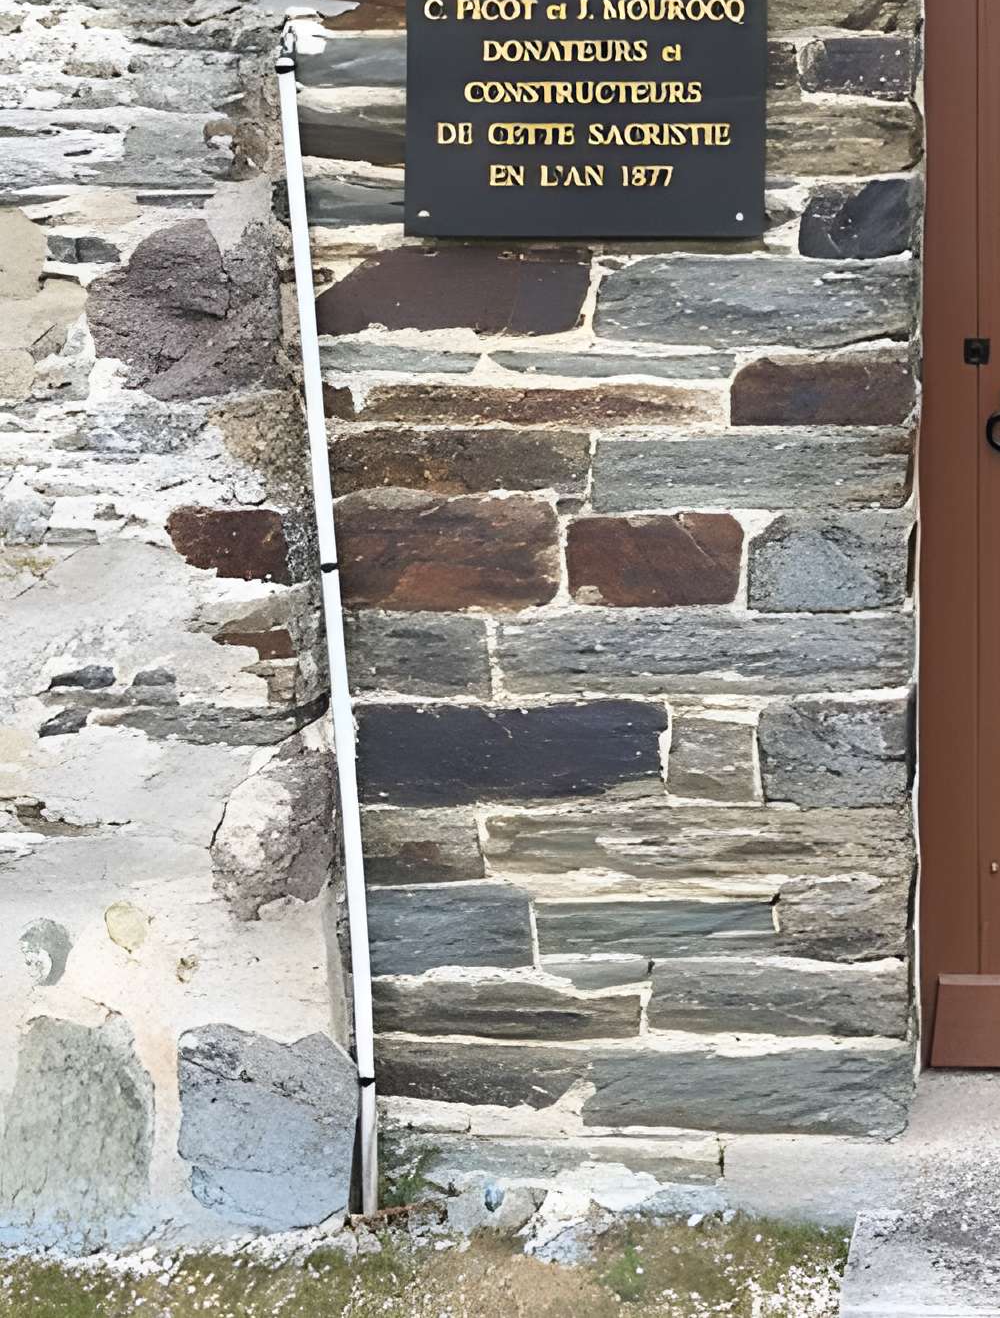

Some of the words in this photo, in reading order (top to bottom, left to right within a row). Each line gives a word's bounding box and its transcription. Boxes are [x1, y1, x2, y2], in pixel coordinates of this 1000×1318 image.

[482, 39, 648, 62] DONATEURS
[463, 81, 702, 103] CONSTRUCTEURS
[437, 122, 473, 145] DE
[488, 122, 575, 145] CETTE
[588, 122, 731, 145] SACRISTIE
[489, 164, 524, 186] EN
[540, 164, 604, 186] L'AN
[621, 164, 674, 186] 1877
